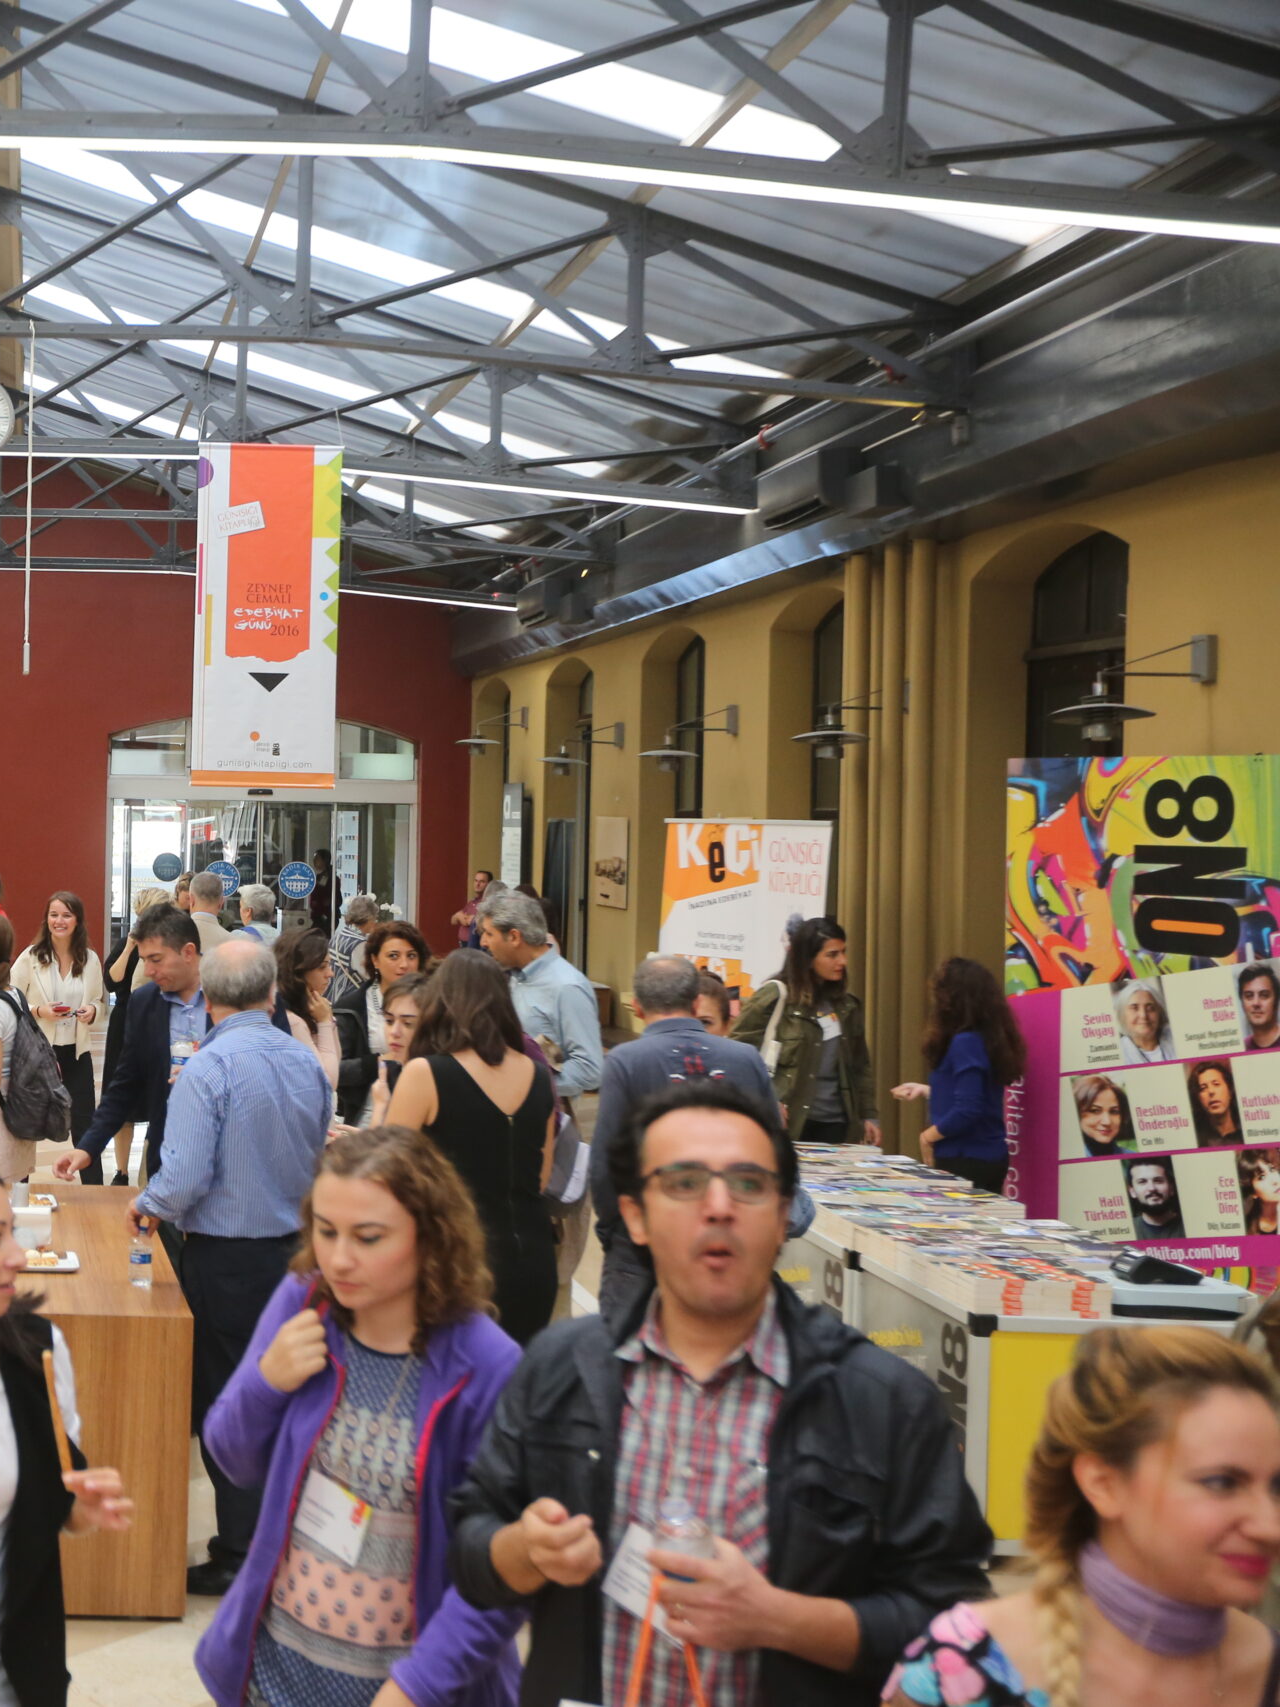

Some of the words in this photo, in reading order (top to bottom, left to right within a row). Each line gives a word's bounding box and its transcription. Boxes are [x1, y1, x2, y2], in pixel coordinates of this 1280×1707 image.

[247, 583, 292, 594] ZEYNEP
[246, 593, 291, 604] CEMALİ
[233, 606, 304, 620] EDEBİYAT
[234, 619, 272, 631] GÜNÜ
[270, 624, 299, 637] 2016
[217, 759, 313, 769] gunisigikitapligi.com
[1133, 775, 1248, 958] ON8
[1083, 1013, 1112, 1026] Sevin
[1081, 1025, 1115, 1039] Okyay
[1219, 1176, 1235, 1187] Ece
[1099, 1196, 1124, 1208] Halil
[1084, 1208, 1127, 1221] Türkden
[1146, 1245, 1240, 1262] 8kitap.com/blog
